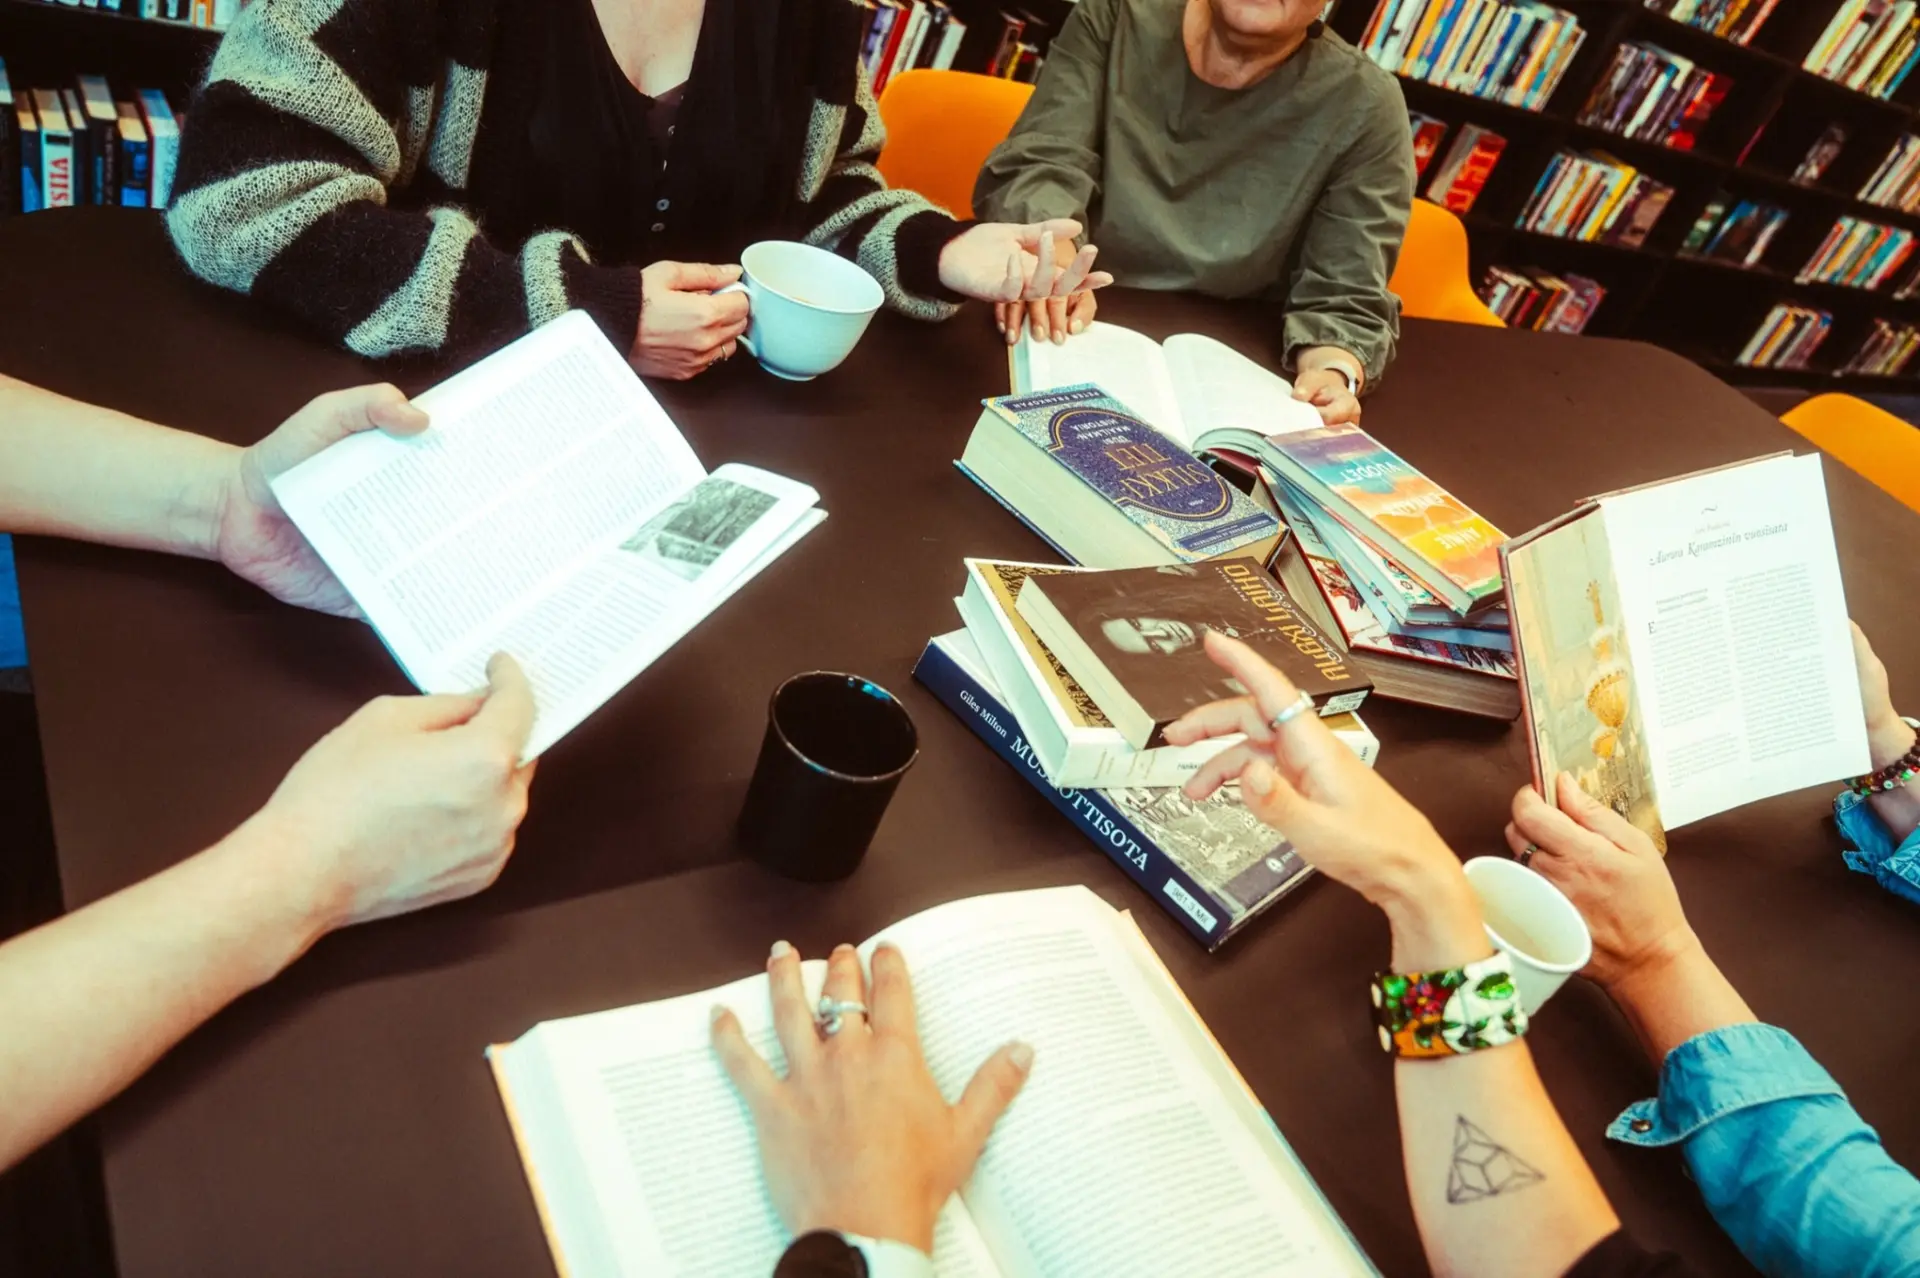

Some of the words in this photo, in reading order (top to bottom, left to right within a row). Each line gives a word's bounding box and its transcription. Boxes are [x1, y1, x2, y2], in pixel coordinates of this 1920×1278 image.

[50, 158, 69, 207] VIIS
[1070, 418, 1119, 432] HISTORIA
[1104, 442, 1172, 471] TIET
[1339, 461, 1402, 484] VUODET
[1119, 463, 1211, 499] SILKKI
[1223, 563, 1293, 621] LAIHO
[959, 690, 981, 713] Giles
[979, 709, 1008, 739] Milton
[1009, 736, 1150, 872] MUSOTTISOTA
